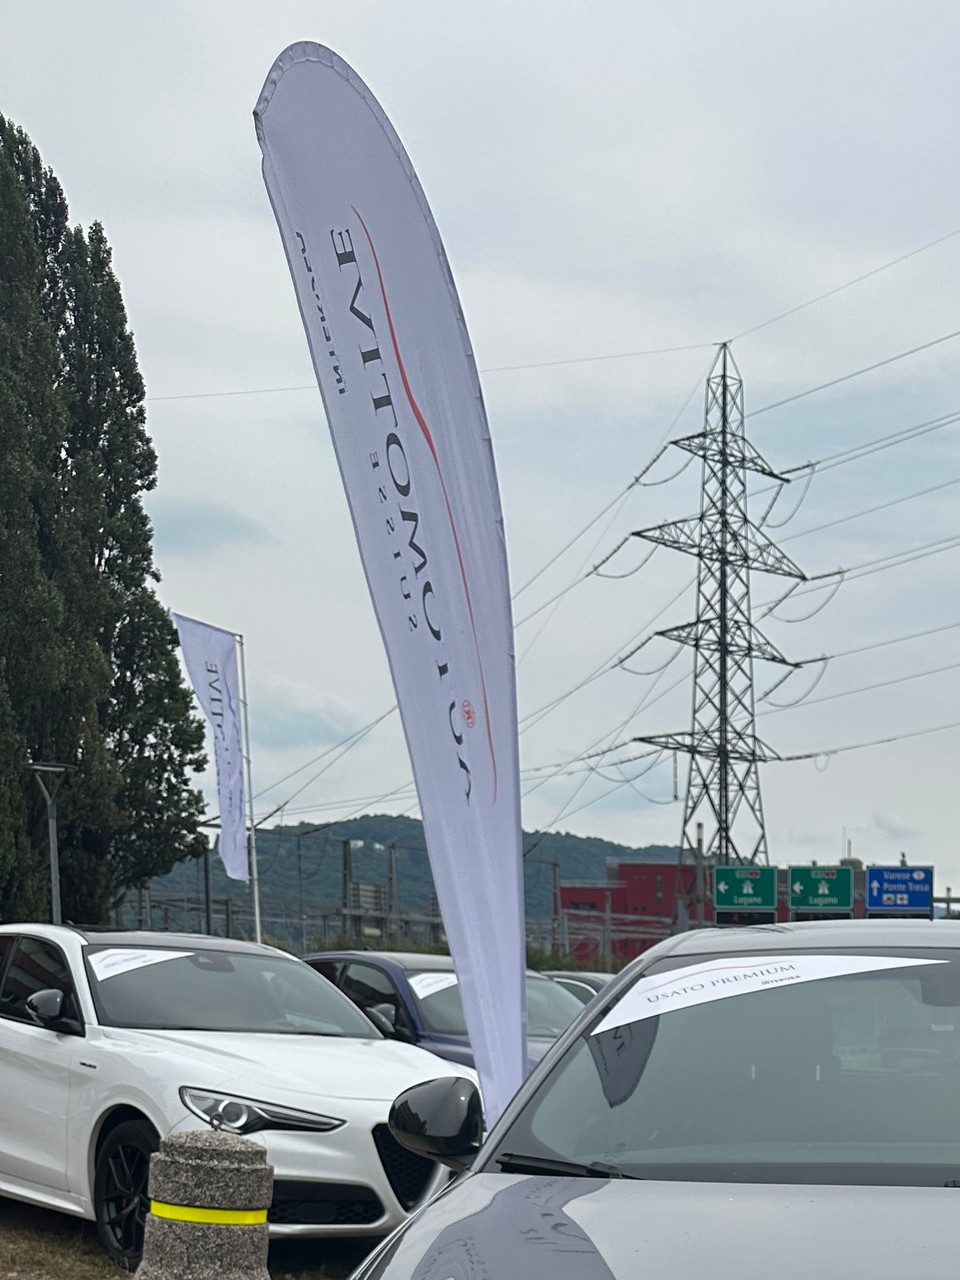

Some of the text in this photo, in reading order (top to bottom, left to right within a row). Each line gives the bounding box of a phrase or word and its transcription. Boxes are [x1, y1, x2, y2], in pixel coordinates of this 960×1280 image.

[883, 871, 911, 880] Varese
[883, 882, 930, 891] Ponte Tresa
[733, 896, 763, 905] Lugano
[808, 896, 839, 906] Lugano
[646, 964, 796, 1003] USATO PREMIUM
